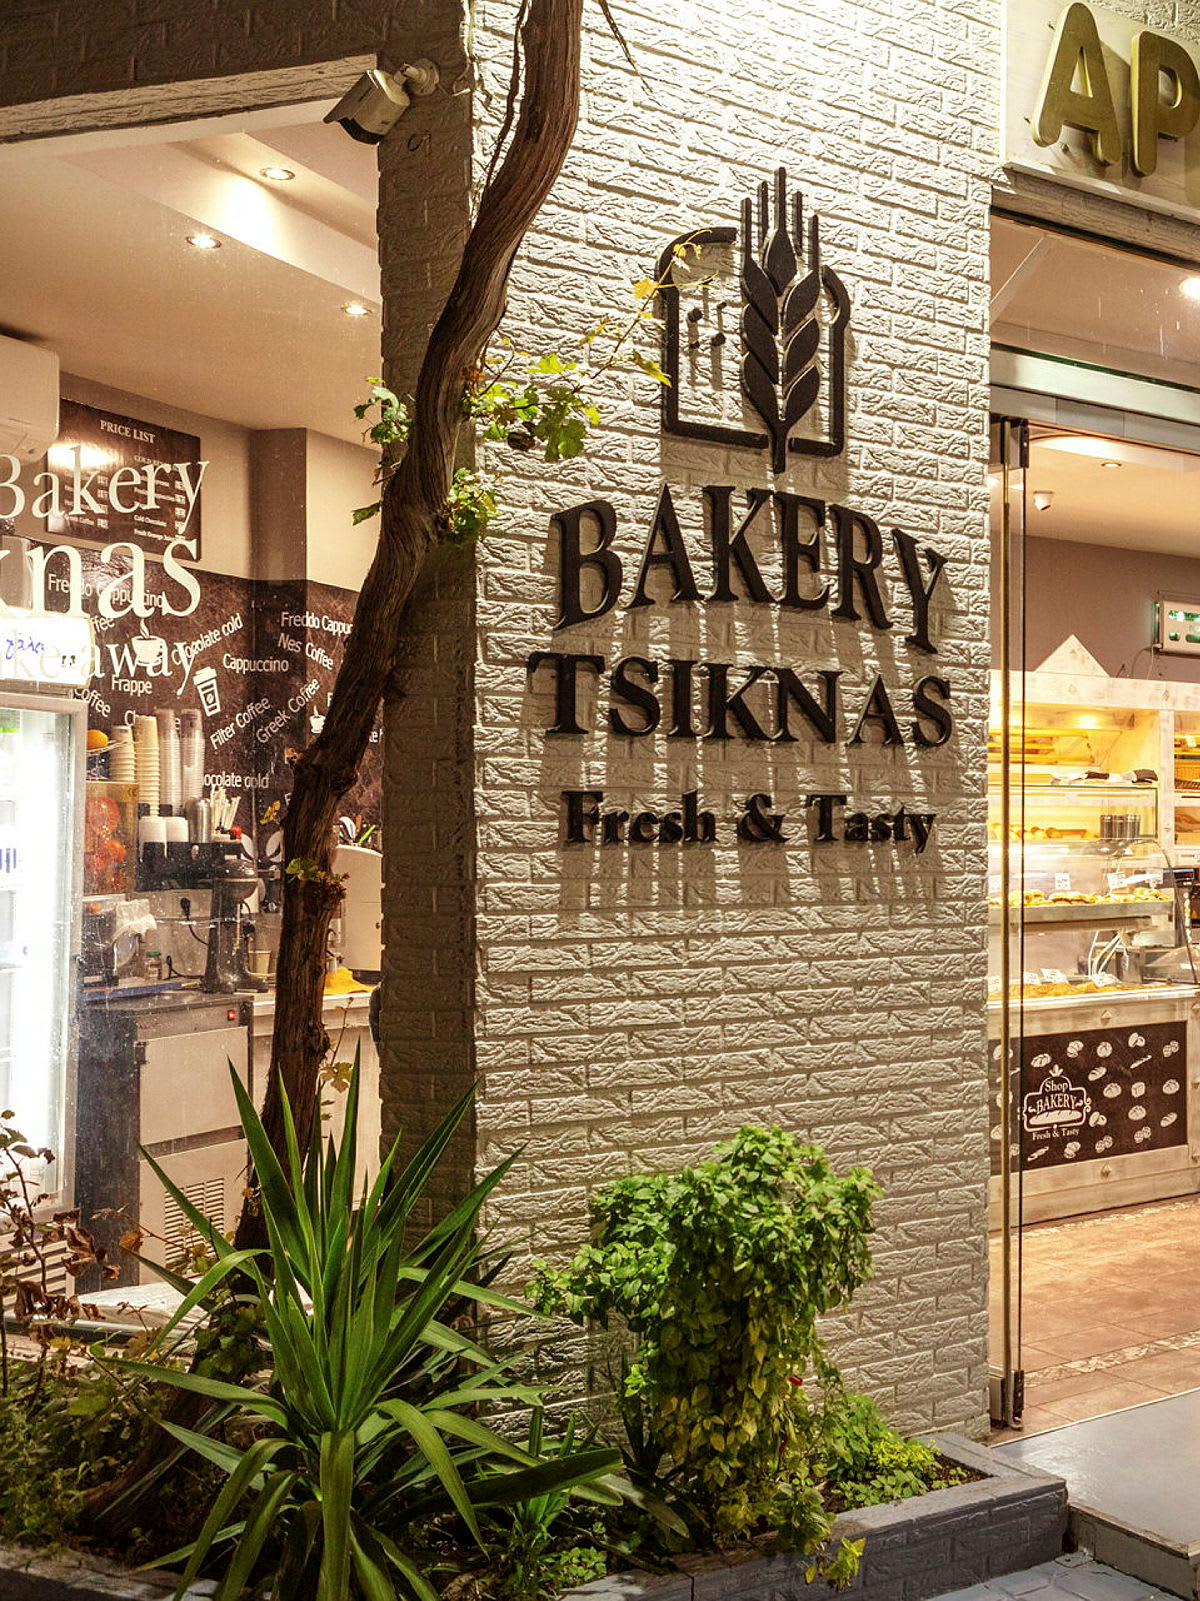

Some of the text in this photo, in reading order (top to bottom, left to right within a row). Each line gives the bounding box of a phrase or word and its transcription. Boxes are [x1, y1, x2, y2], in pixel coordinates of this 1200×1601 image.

[100, 419, 156, 444] PRICE LIST
[0, 444, 210, 534] Bakery
[0, 537, 201, 618] nas
[48, 573, 93, 597] Freo
[550, 483, 949, 654] BAKERY
[171, 612, 243, 666] Cocolate cold
[281, 611, 353, 637] Freddo Cappuc
[223, 653, 289, 675] Cappuccino
[277, 632, 334, 671] Nes Coffee
[111, 675, 153, 697] Frappe
[527, 652, 952, 747] TSIKNAS
[210, 697, 271, 750] Filter Coffee
[256, 678, 320, 744] Greek Coffee
[204, 772, 269, 788] ocolate cold
[561, 788, 937, 854] Fresh & Tasty
[1036, 1093, 1077, 1115] BAKERY
[1044, 1080, 1069, 1093] Shop
